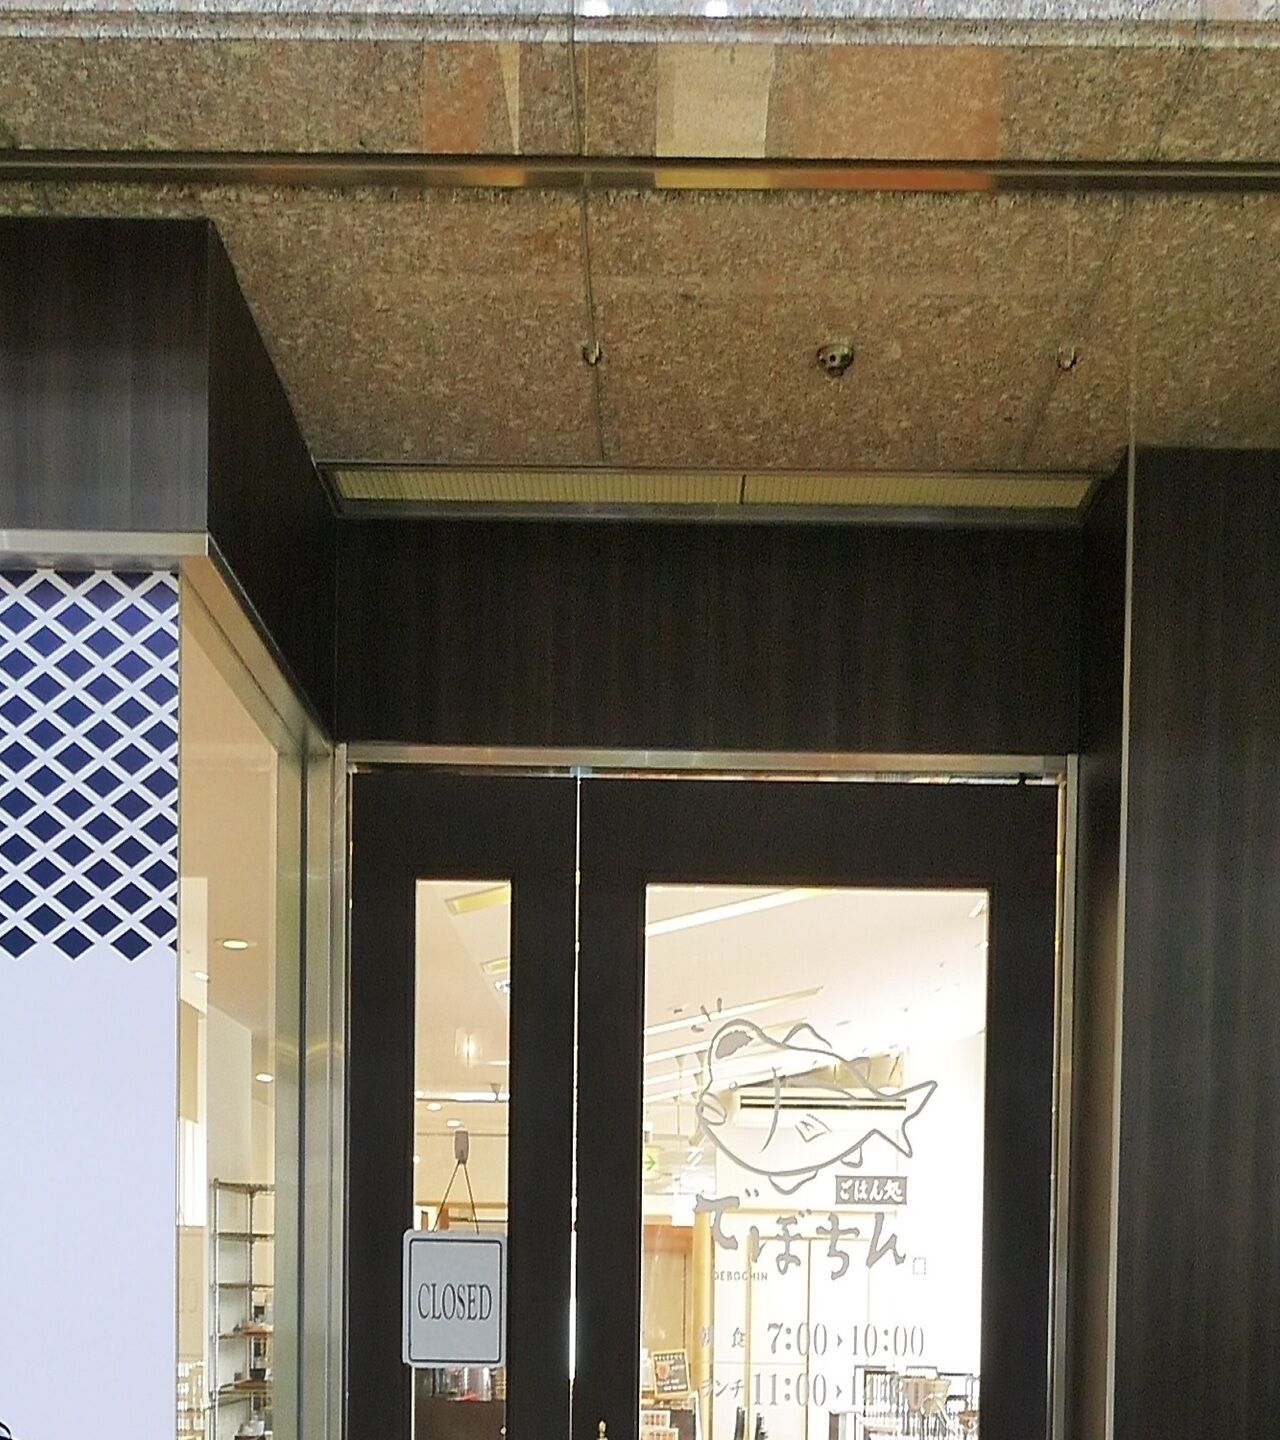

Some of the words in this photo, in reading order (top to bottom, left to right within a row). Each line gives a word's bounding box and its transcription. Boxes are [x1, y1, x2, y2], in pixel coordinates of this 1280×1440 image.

[839, 1178, 904, 1202] ごはん処
[693, 1188, 907, 1281] でぼちん
[713, 1270, 768, 1281] DEBOCHIN
[417, 1283, 493, 1321] CLOSED
[767, 1322, 828, 1356] 7:00
[852, 1323, 924, 1357] 10:00
[753, 1372, 827, 1407] 11:00
